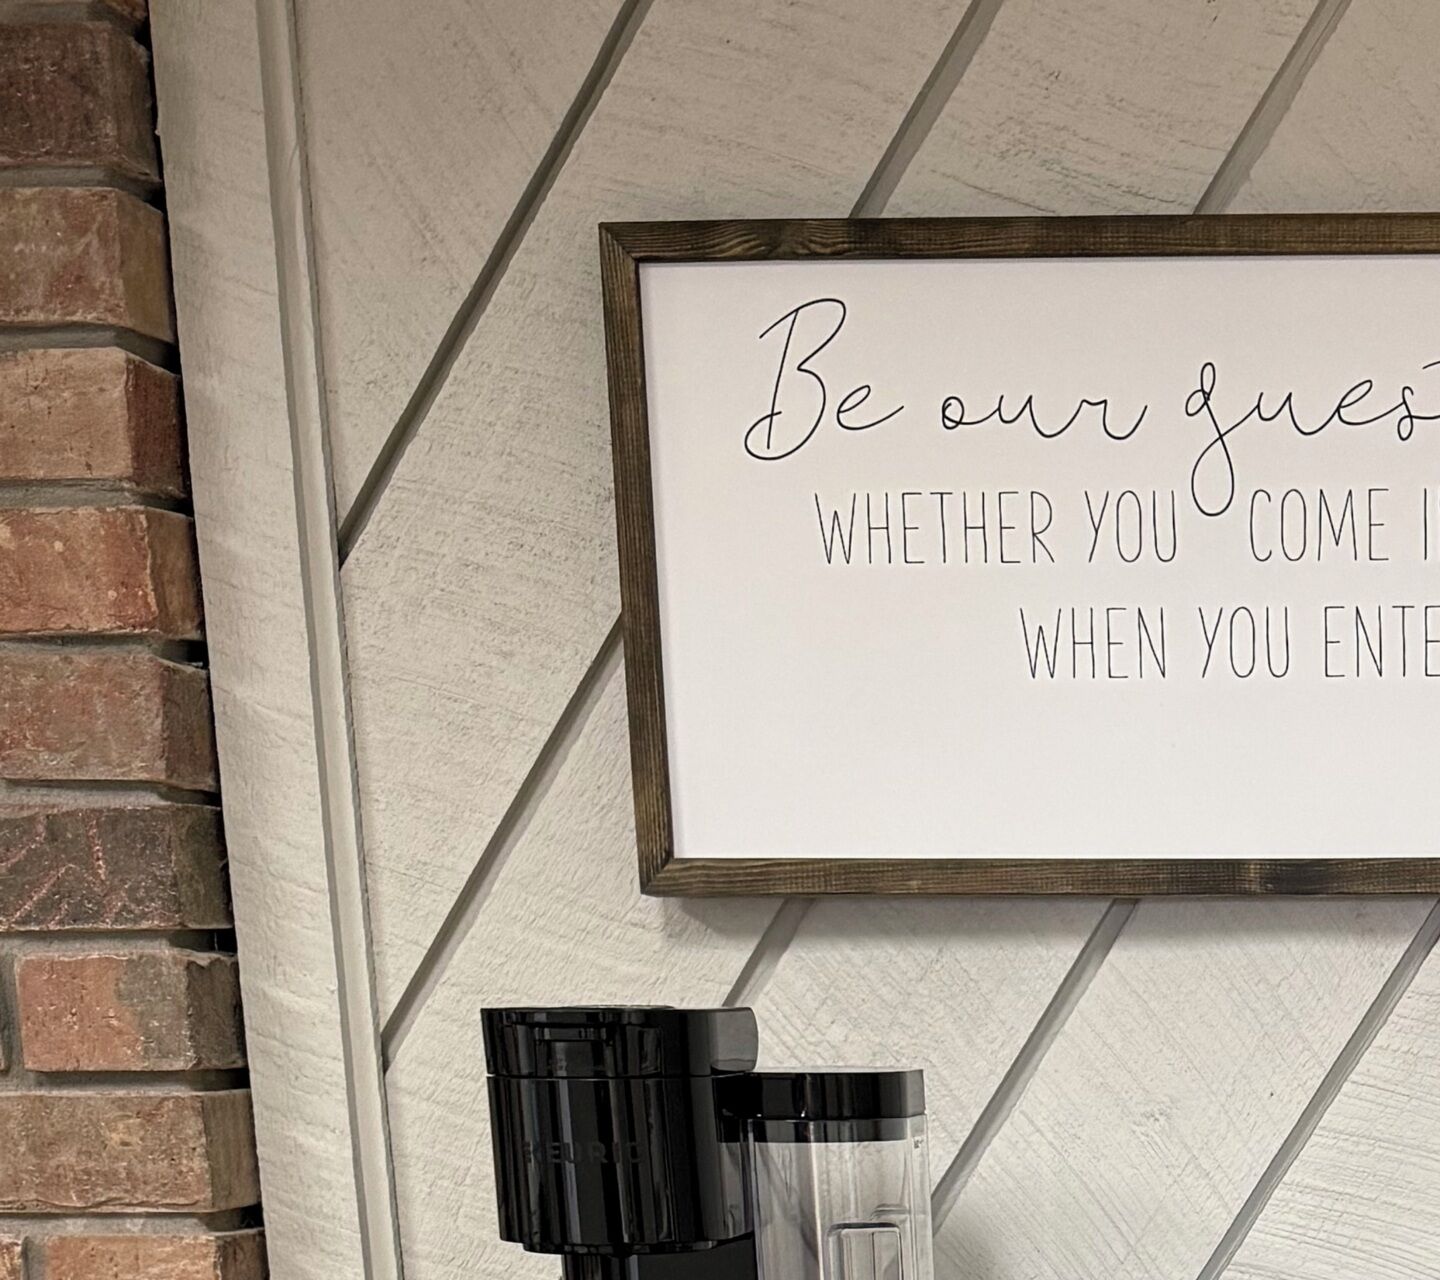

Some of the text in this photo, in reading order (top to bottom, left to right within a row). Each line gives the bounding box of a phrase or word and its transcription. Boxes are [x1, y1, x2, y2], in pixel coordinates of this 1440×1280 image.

[743, 297, 905, 462] Be
[940, 394, 1149, 441] our
[814, 490, 1056, 565] WHETHER
[1083, 489, 1178, 564] YOU
[1249, 487, 1391, 563] COME
[1019, 606, 1168, 680] WHEN
[1197, 605, 1291, 679] YOU
